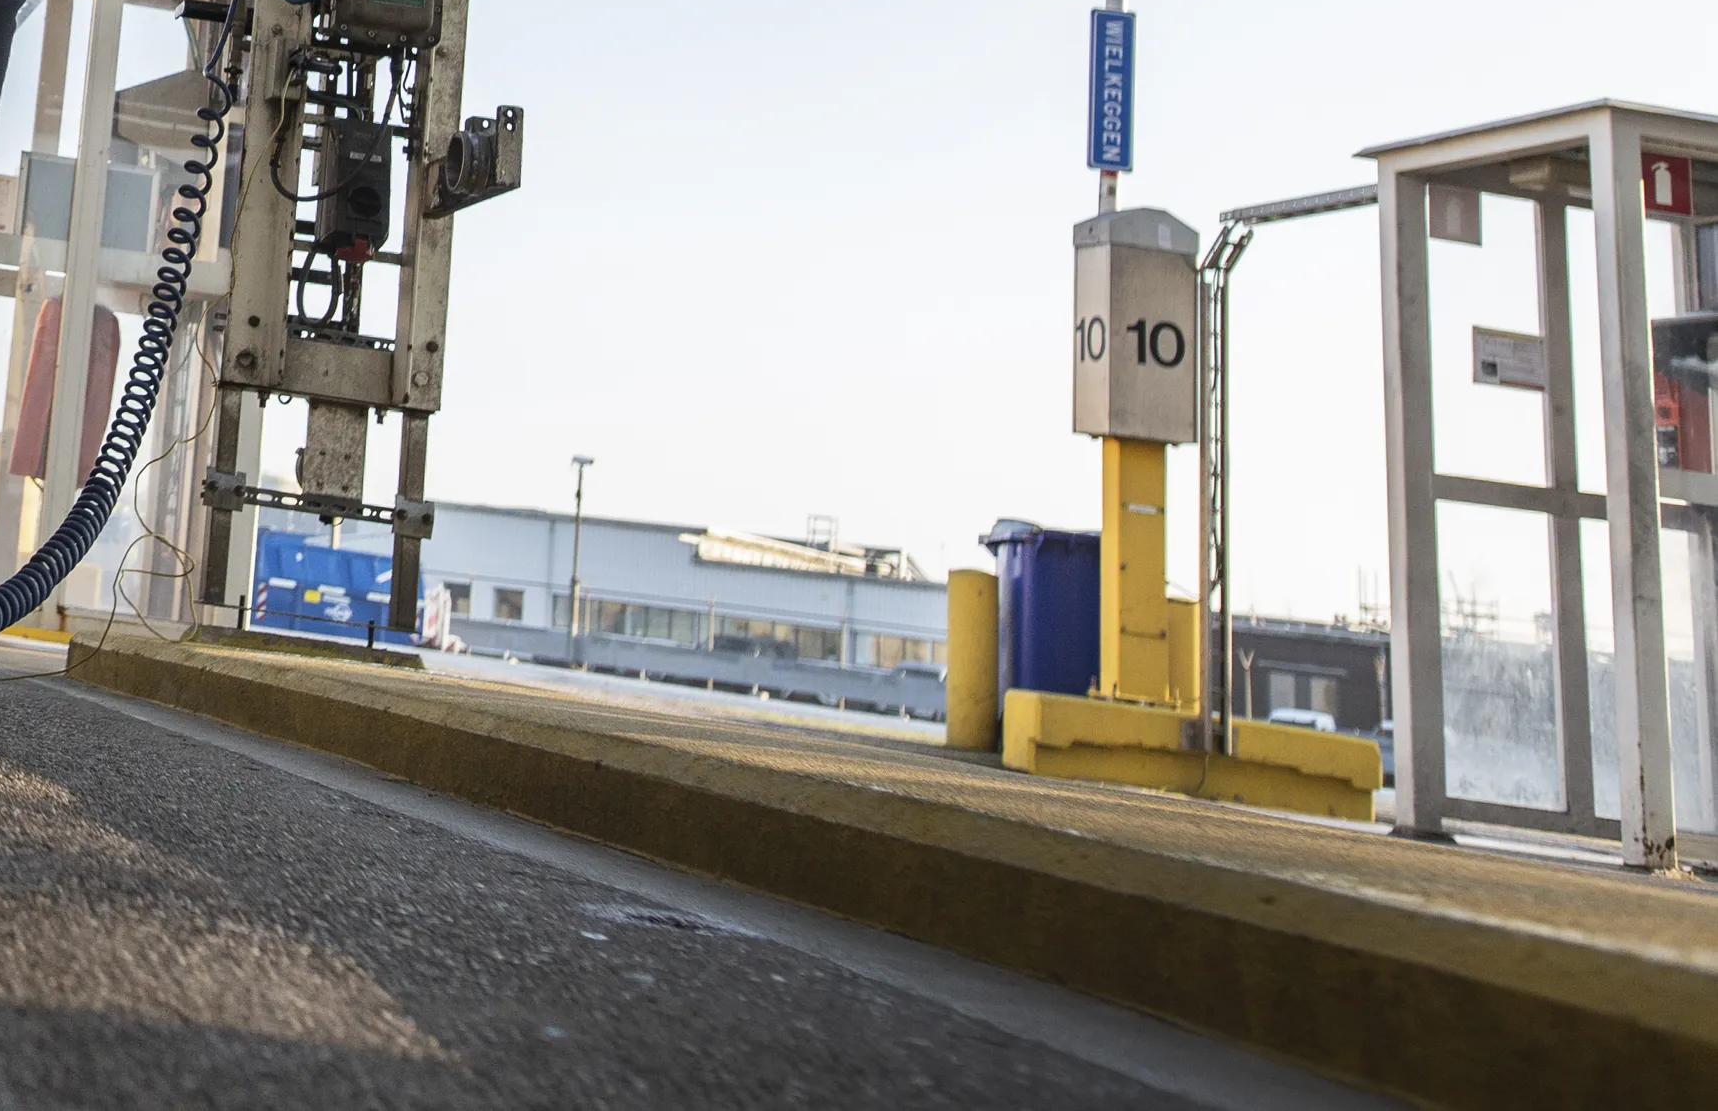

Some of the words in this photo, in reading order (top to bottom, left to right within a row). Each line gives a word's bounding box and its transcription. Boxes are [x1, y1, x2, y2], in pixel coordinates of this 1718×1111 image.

[1101, 19, 1125, 163] WIELKEGGEN
[1075, 316, 1106, 362] 10
[1126, 318, 1186, 368] 10
